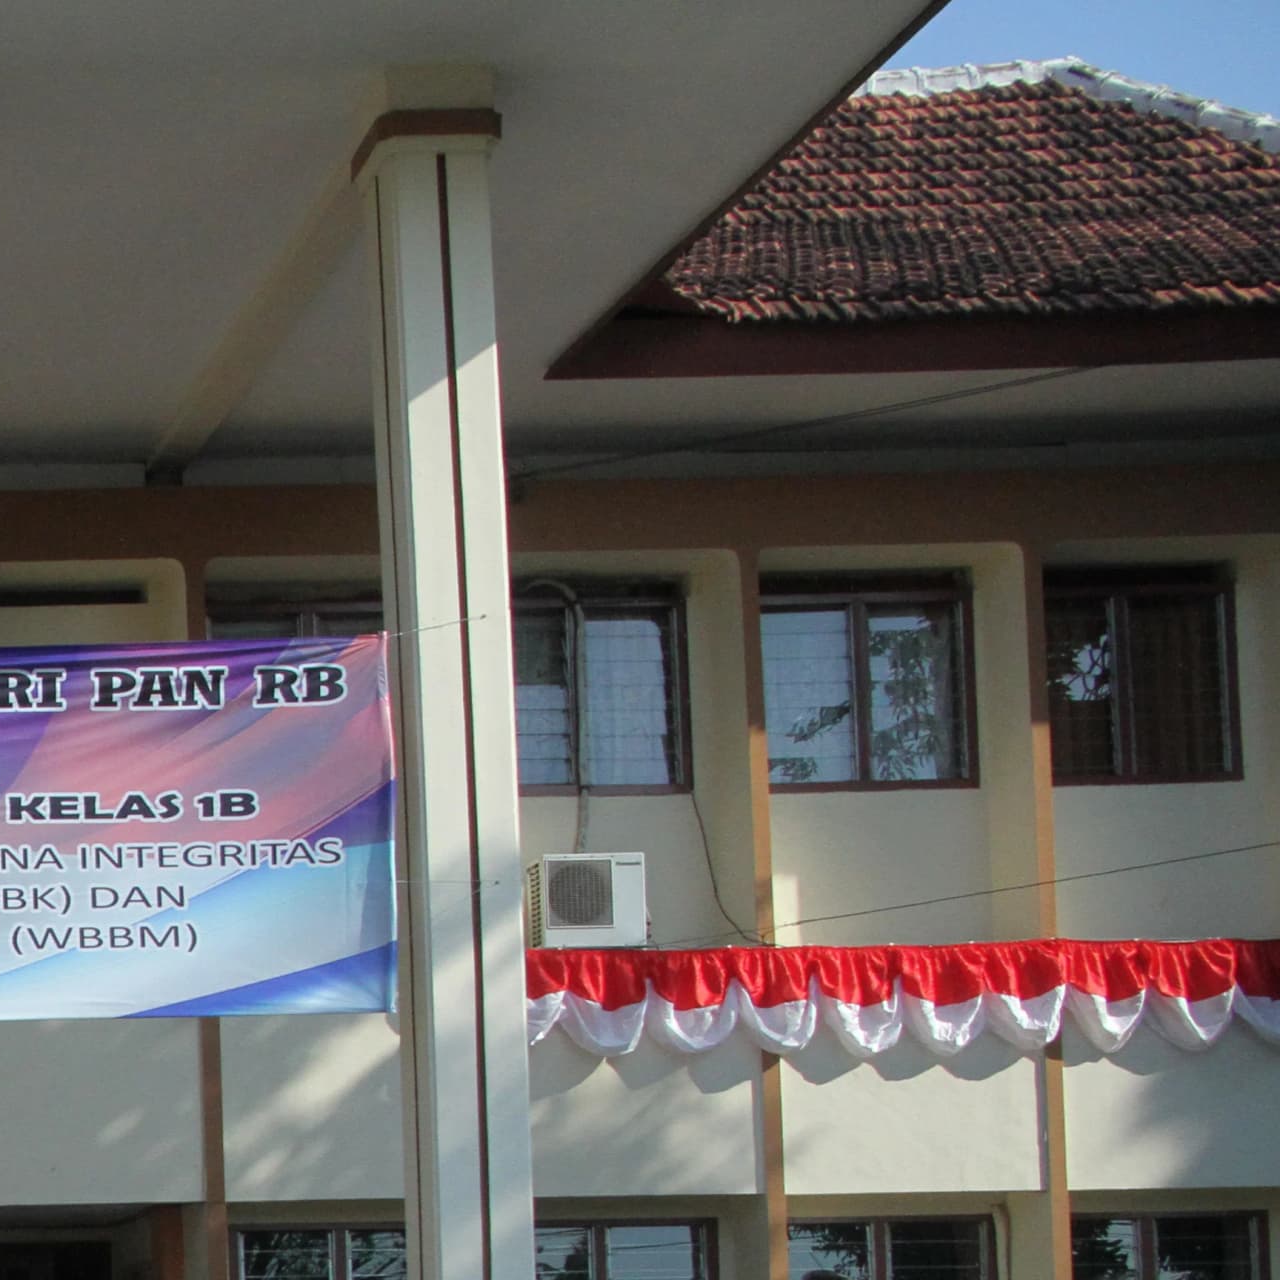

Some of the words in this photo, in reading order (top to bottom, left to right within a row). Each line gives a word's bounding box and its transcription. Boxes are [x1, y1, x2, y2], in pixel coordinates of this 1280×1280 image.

[92, 669, 226, 708] PAN
[254, 665, 346, 705] RB
[8, 793, 180, 823] KELAS
[196, 791, 257, 818] 1B
[80, 840, 342, 869] INTEGRITAS
[90, 885, 186, 909] DAN
[11, 923, 198, 955] (WBBM)
